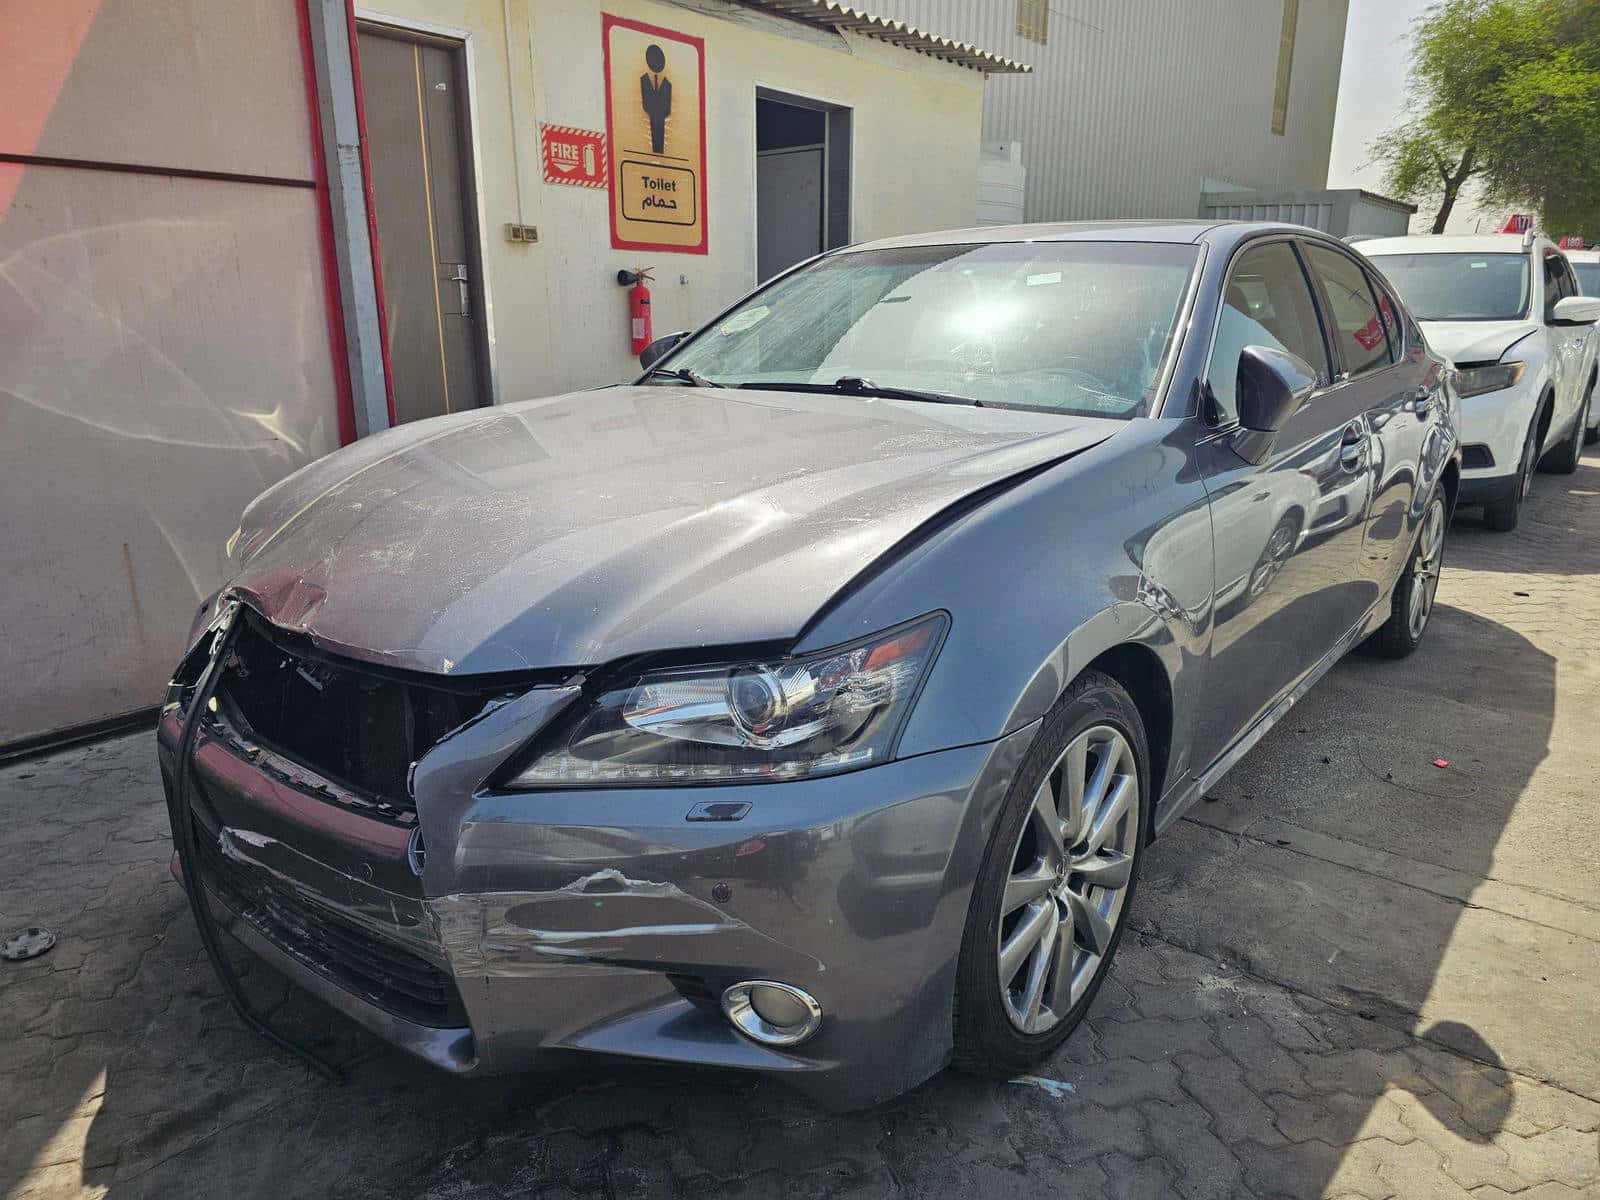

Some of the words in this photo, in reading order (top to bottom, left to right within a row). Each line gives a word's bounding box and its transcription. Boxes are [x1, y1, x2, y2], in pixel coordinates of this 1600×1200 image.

[551, 142, 579, 159] FIRE
[641, 176, 676, 192] Toilet
[641, 195, 677, 210] حمام
